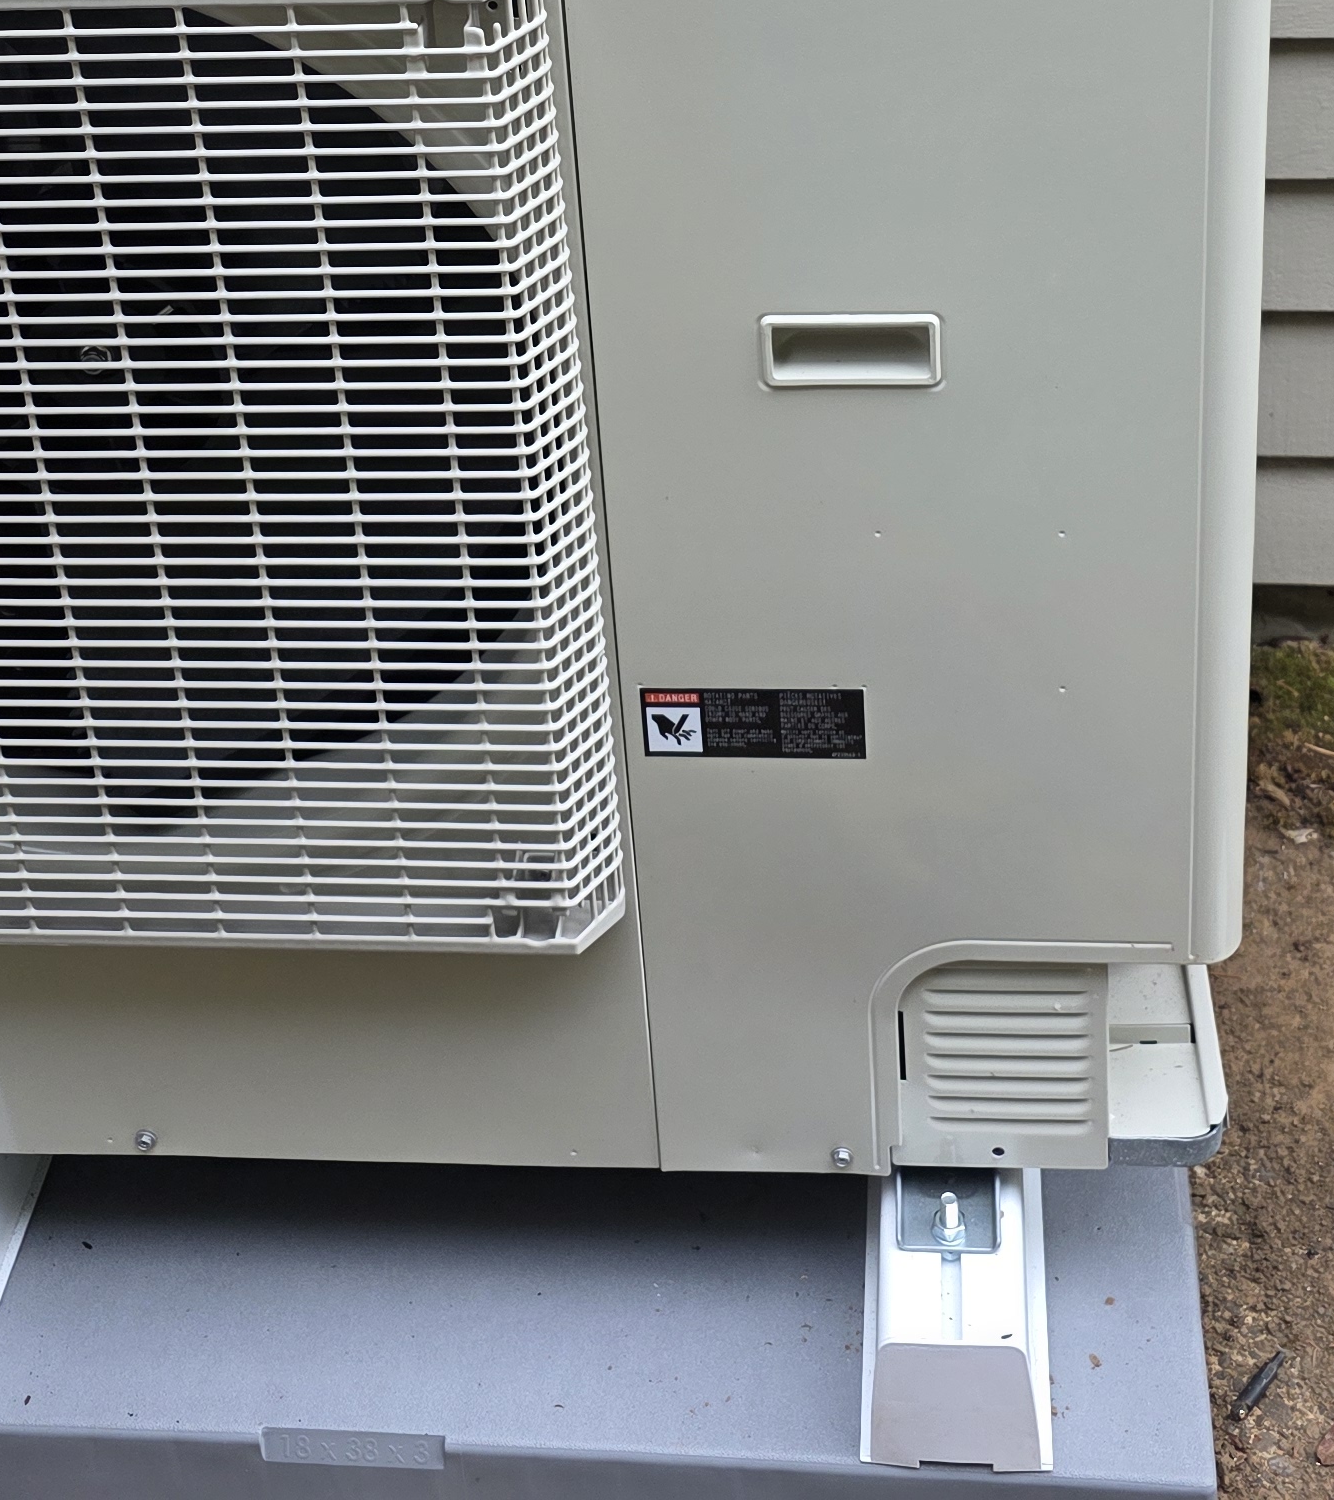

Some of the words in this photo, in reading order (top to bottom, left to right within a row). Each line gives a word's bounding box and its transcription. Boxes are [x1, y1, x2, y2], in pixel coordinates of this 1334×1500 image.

[658, 693, 698, 702] DANGER
[279, 1434, 312, 1460] 18
[345, 1436, 379, 1463] 38
[413, 1439, 431, 1465] 3
